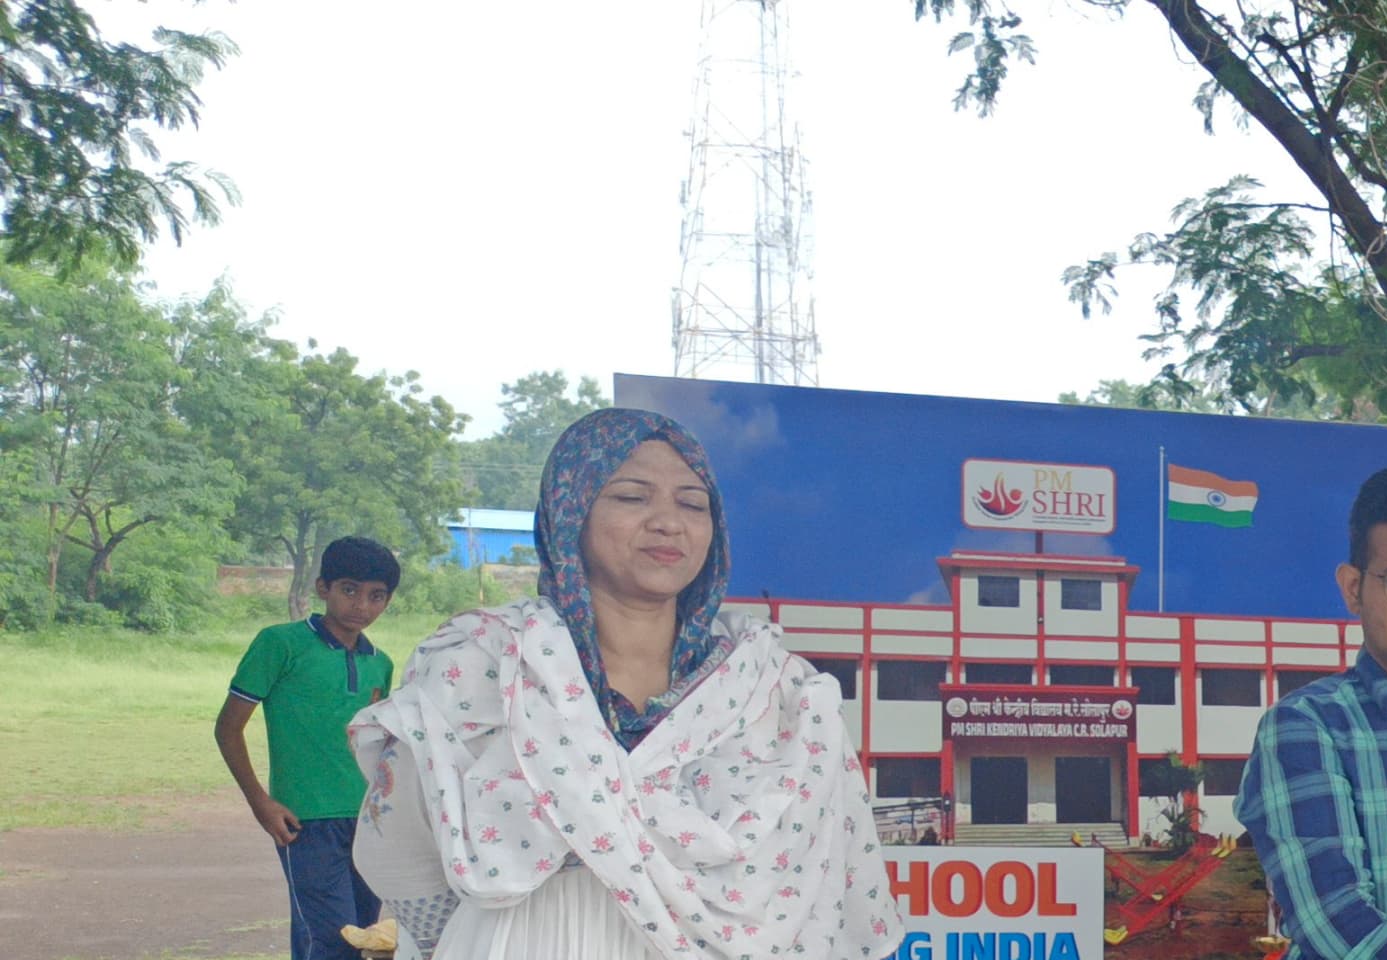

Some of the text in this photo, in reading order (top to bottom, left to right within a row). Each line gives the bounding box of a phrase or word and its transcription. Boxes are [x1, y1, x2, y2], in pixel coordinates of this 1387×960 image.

[1032, 469, 1073, 491] PM
[1032, 489, 1107, 518] SHRI
[951, 722, 965, 736] PM
[966, 722, 986, 736] SHRI
[987, 723, 1029, 737] KENDRIYA
[1029, 723, 1073, 737] VIDYALAYA
[1090, 723, 1128, 738] SOLAPUR
[884, 860, 1077, 918] HOOL
